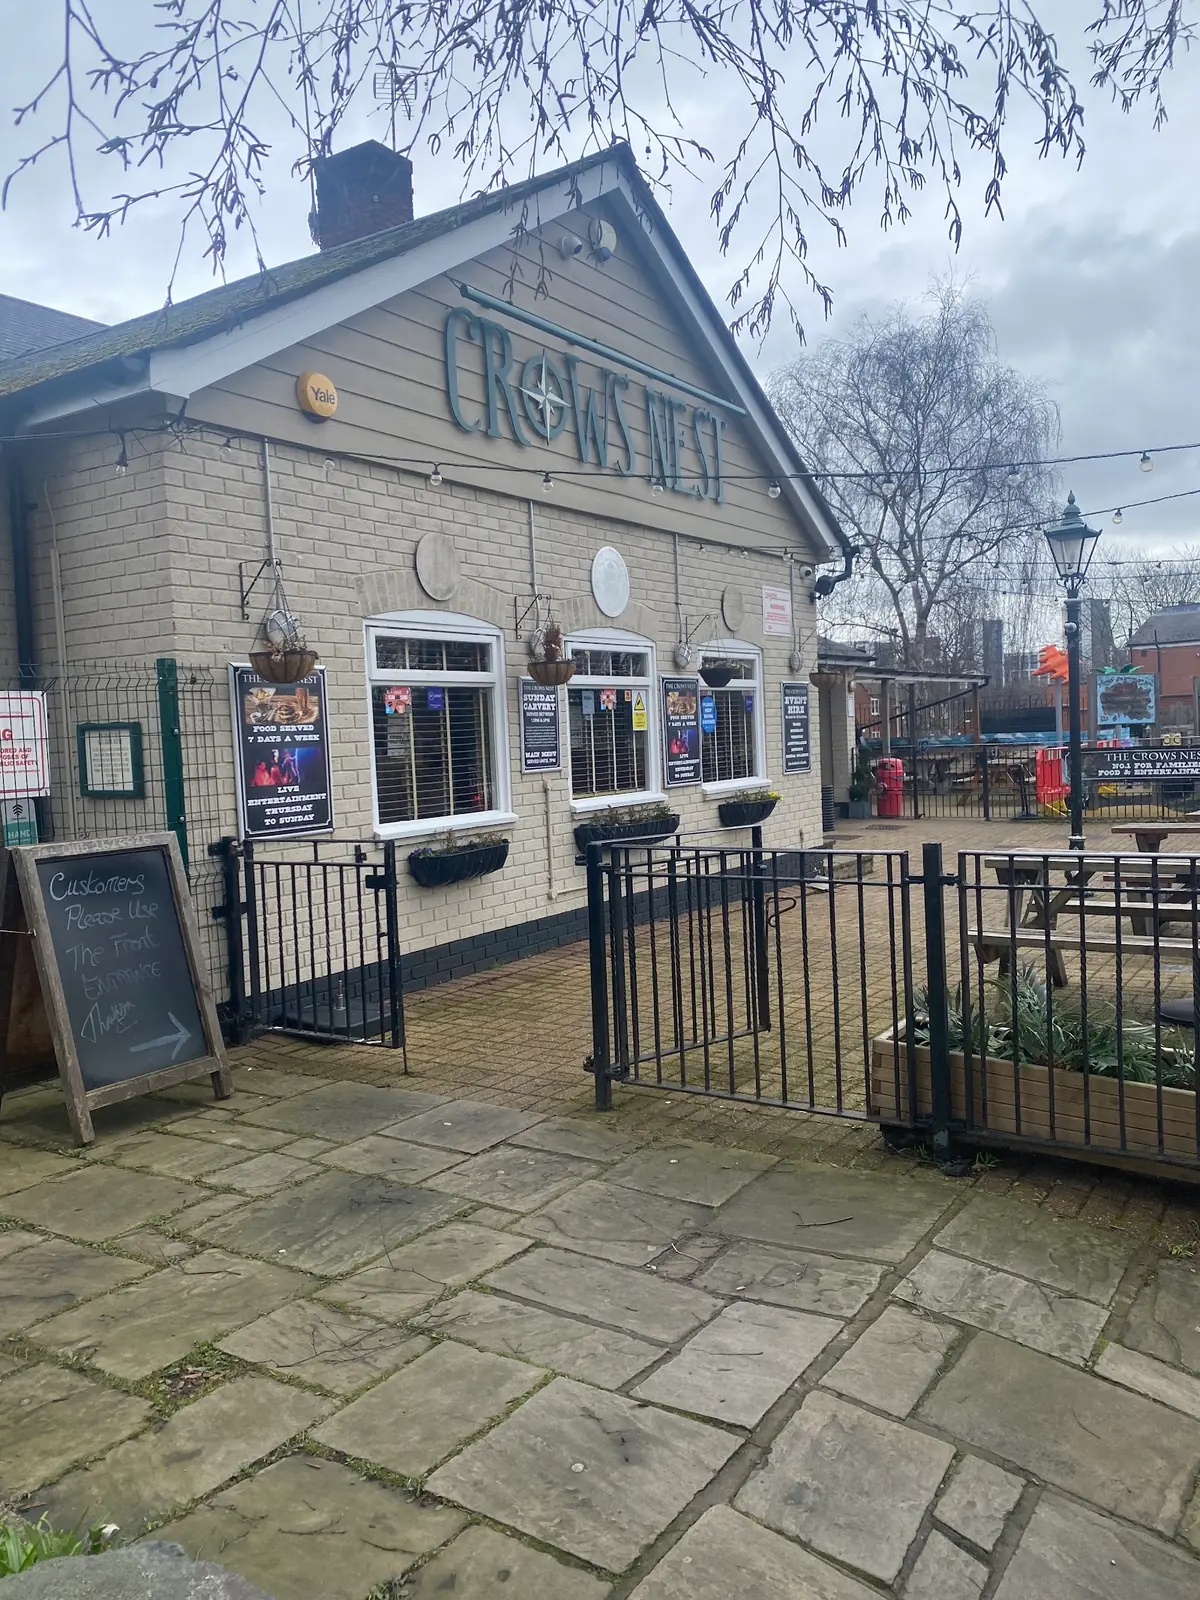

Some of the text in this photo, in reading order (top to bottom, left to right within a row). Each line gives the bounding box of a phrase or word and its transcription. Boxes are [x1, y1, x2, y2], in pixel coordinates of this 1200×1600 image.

[311, 385, 335, 404] Yale
[444, 307, 725, 504] CROWS NEST
[523, 694, 556, 702] SUNDAY
[784, 696, 807, 705] EVENT
[523, 703, 556, 711] CARVERY
[788, 706, 805, 714] HIRE
[1104, 752, 1130, 761] THE
[1132, 751, 1176, 761] CROWS
[1155, 761, 1200, 769] FAMILIE
[277, 785, 299, 793] LIVE
[247, 793, 327, 806] ENTERTAINMENT
[265, 804, 313, 815] THURSDAY
[264, 814, 315, 826] TO SUNDAY
[50, 870, 145, 901] Customers
[65, 900, 159, 932] Please Use
[66, 924, 160, 971] The Front
